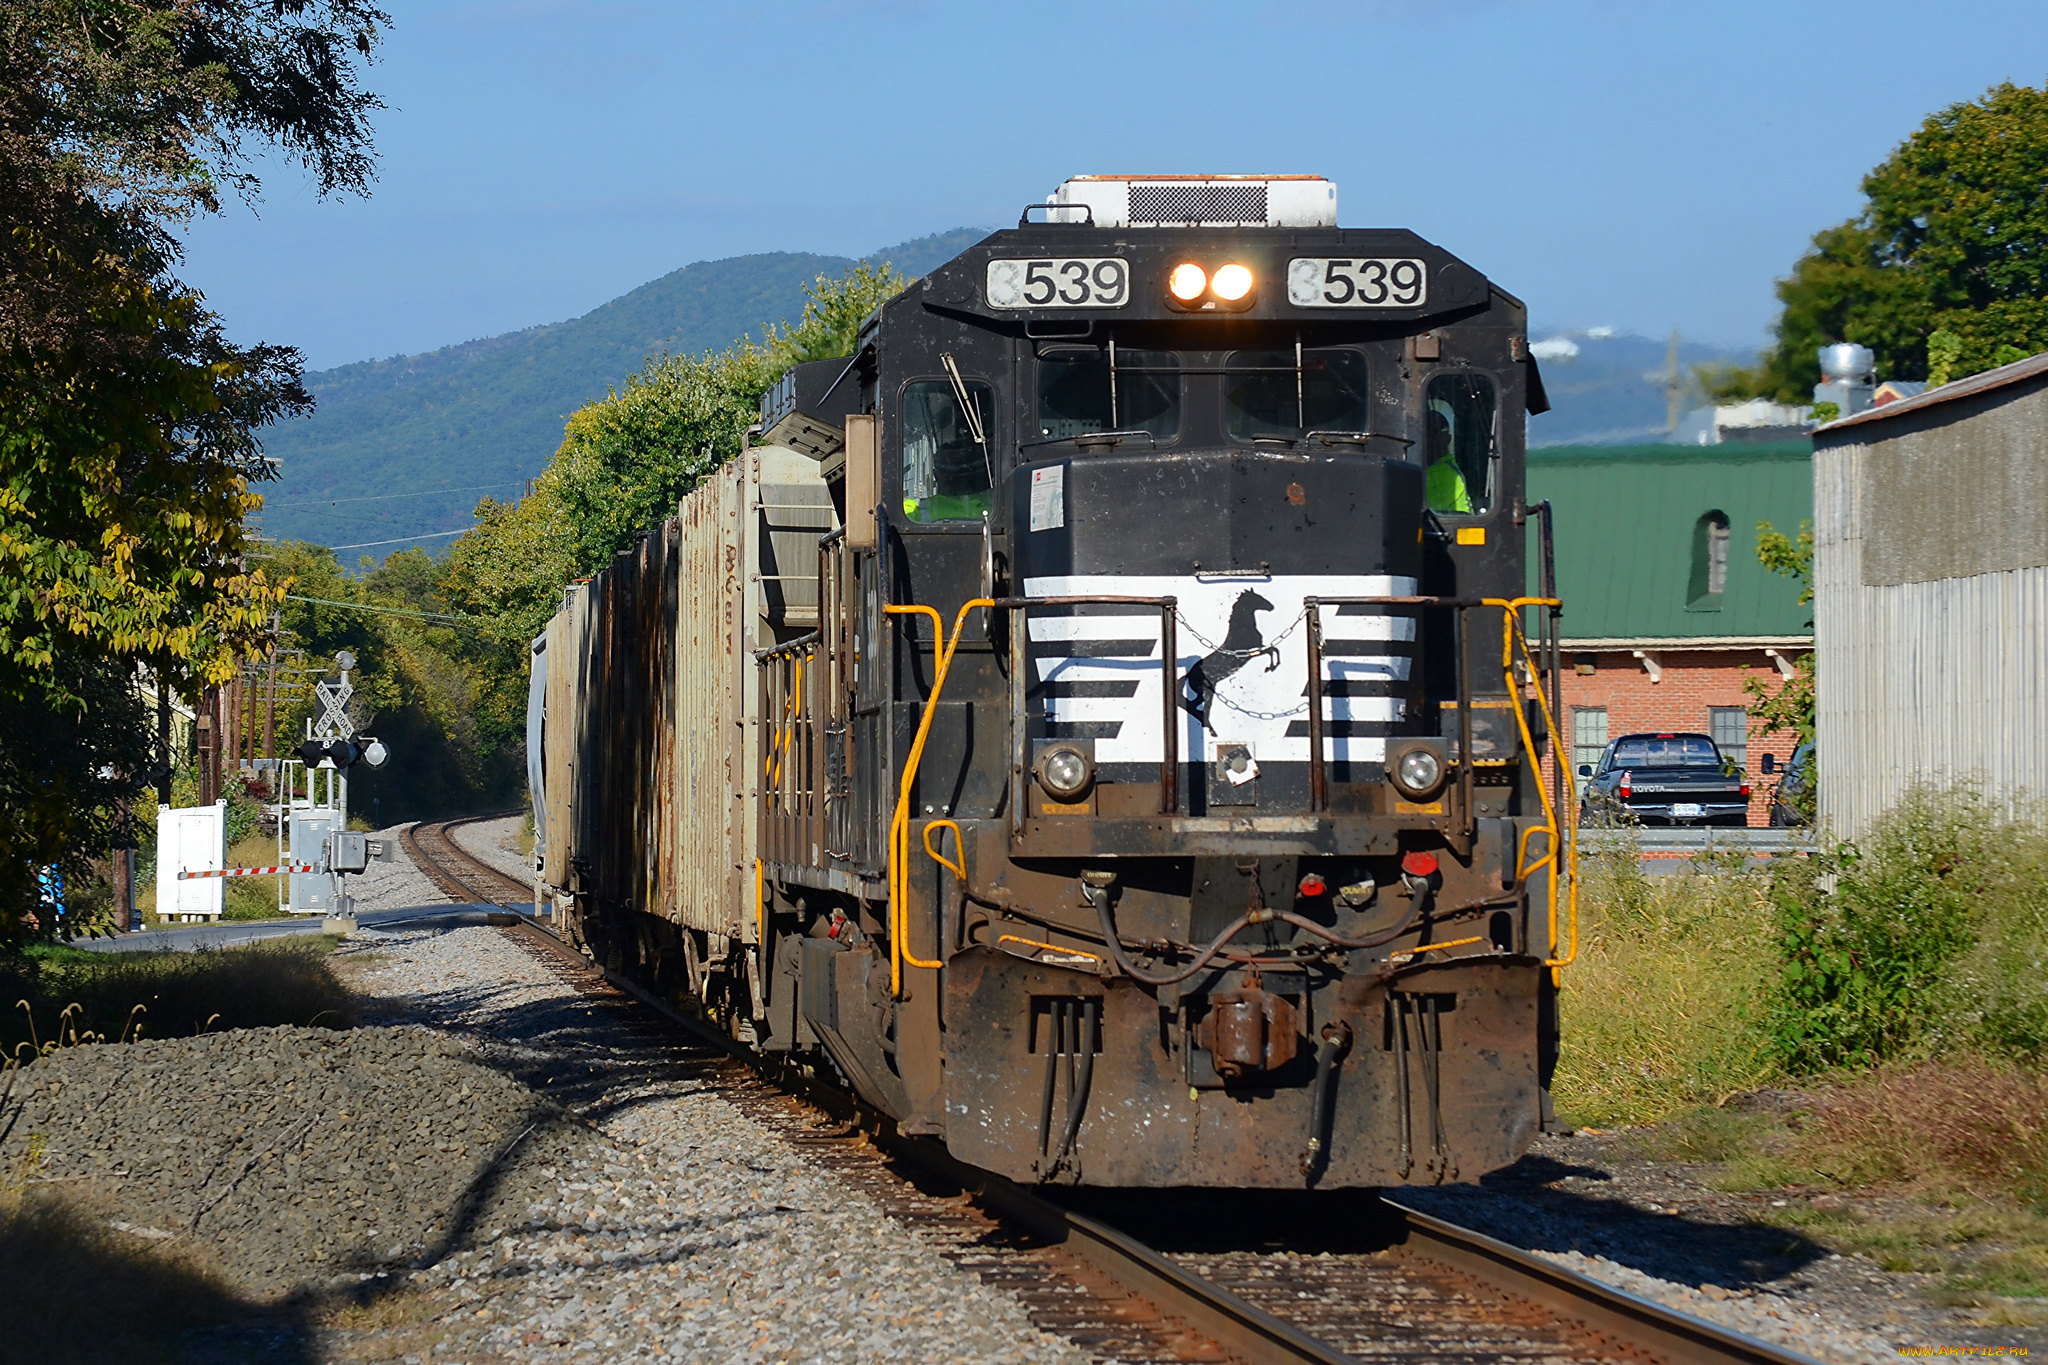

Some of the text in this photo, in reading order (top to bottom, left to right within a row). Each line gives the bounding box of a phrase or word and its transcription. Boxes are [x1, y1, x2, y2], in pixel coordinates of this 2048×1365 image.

[316, 684, 352, 736] RAIL ROAD
[317, 687, 350, 733] CROSSING
[1632, 785, 1665, 793] TOYOTA
